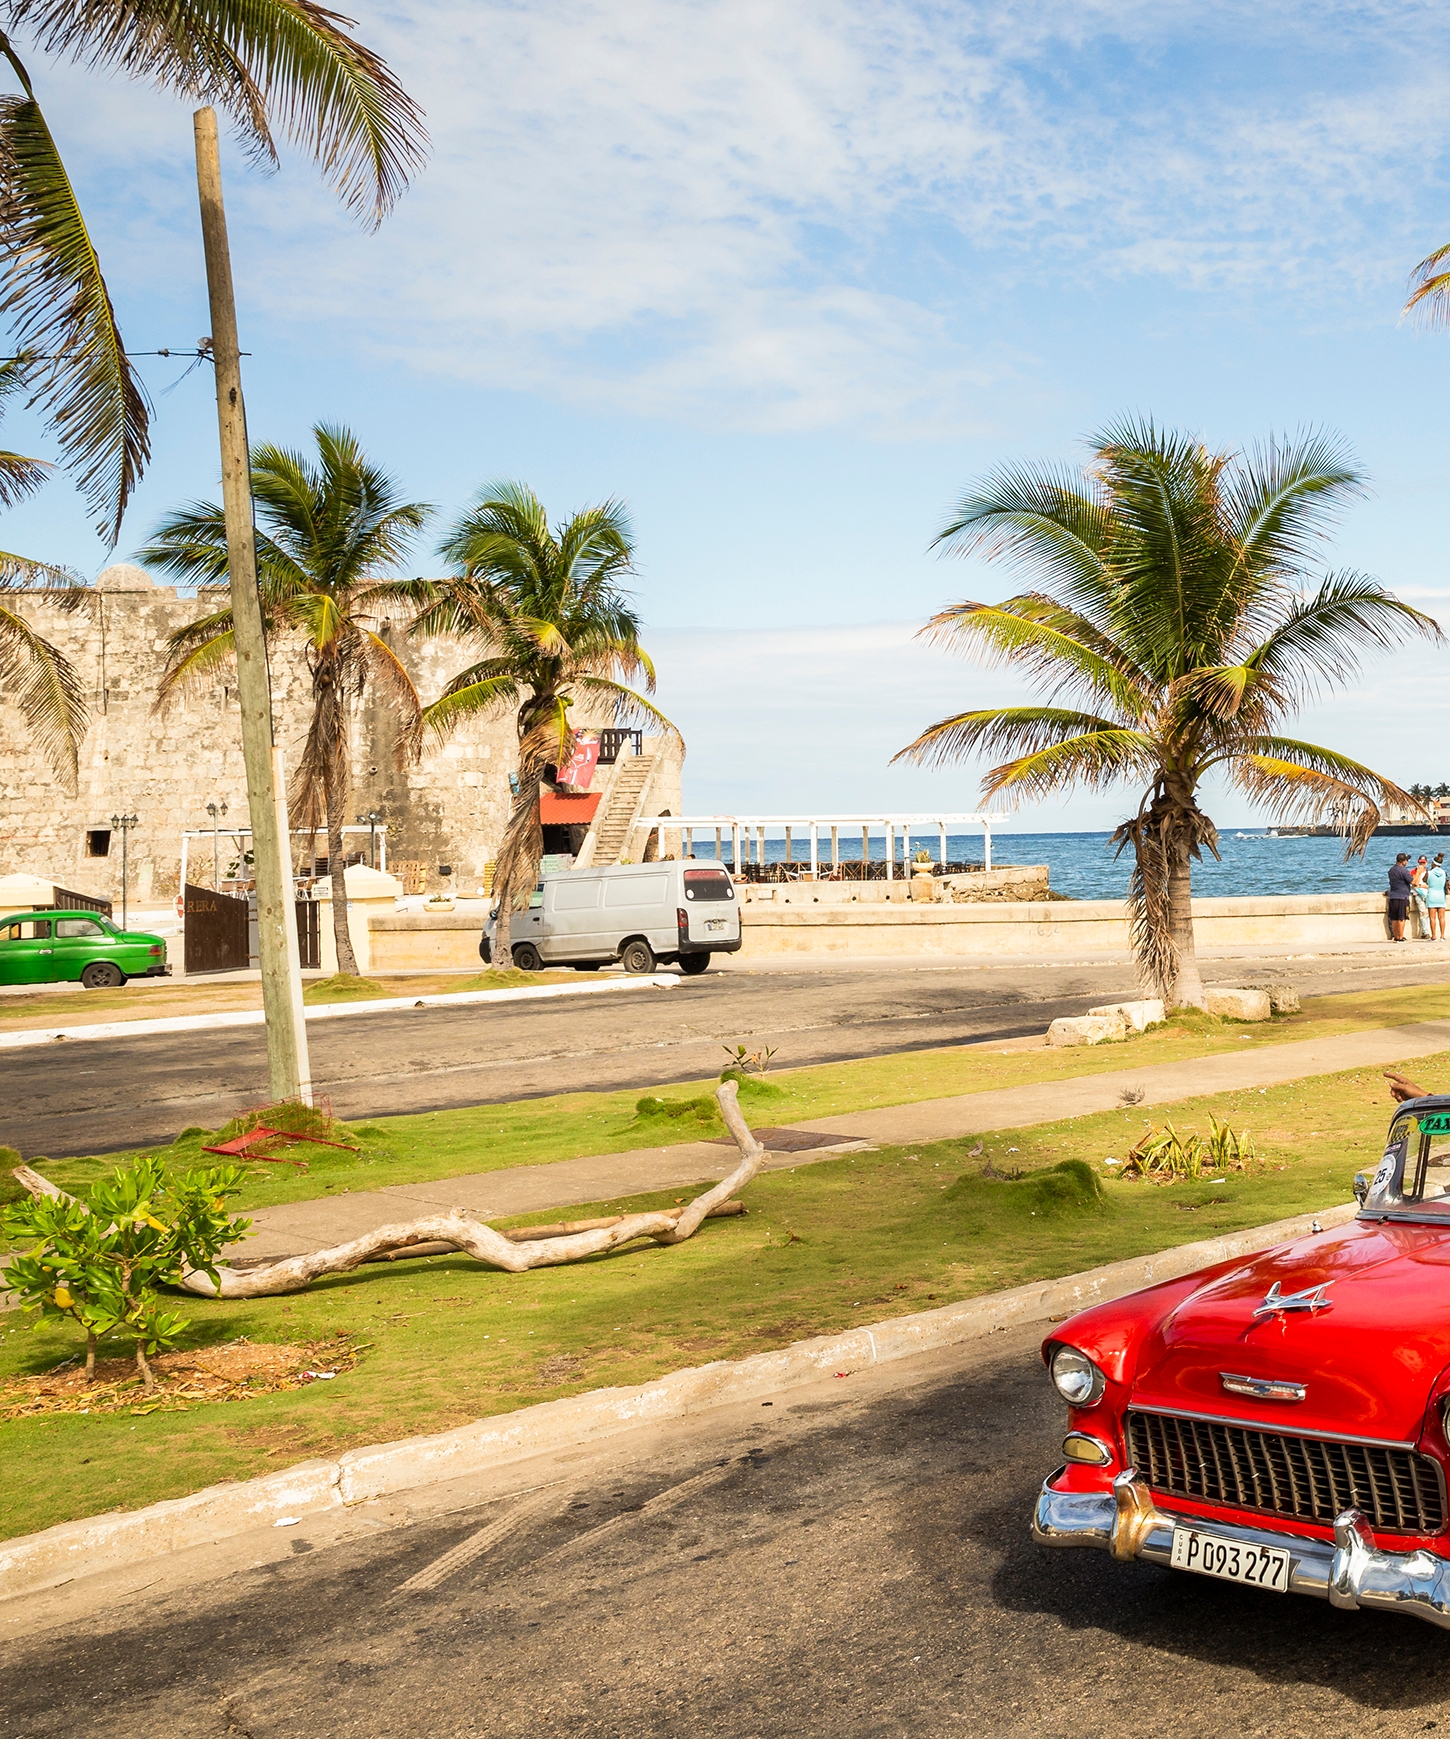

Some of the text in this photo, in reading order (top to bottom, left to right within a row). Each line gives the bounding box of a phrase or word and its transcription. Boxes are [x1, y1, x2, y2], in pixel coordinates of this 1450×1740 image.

[187, 900, 218, 913] RERA
[1373, 1167, 1388, 1186] 25
[1176, 1534, 1184, 1562] CUBA
